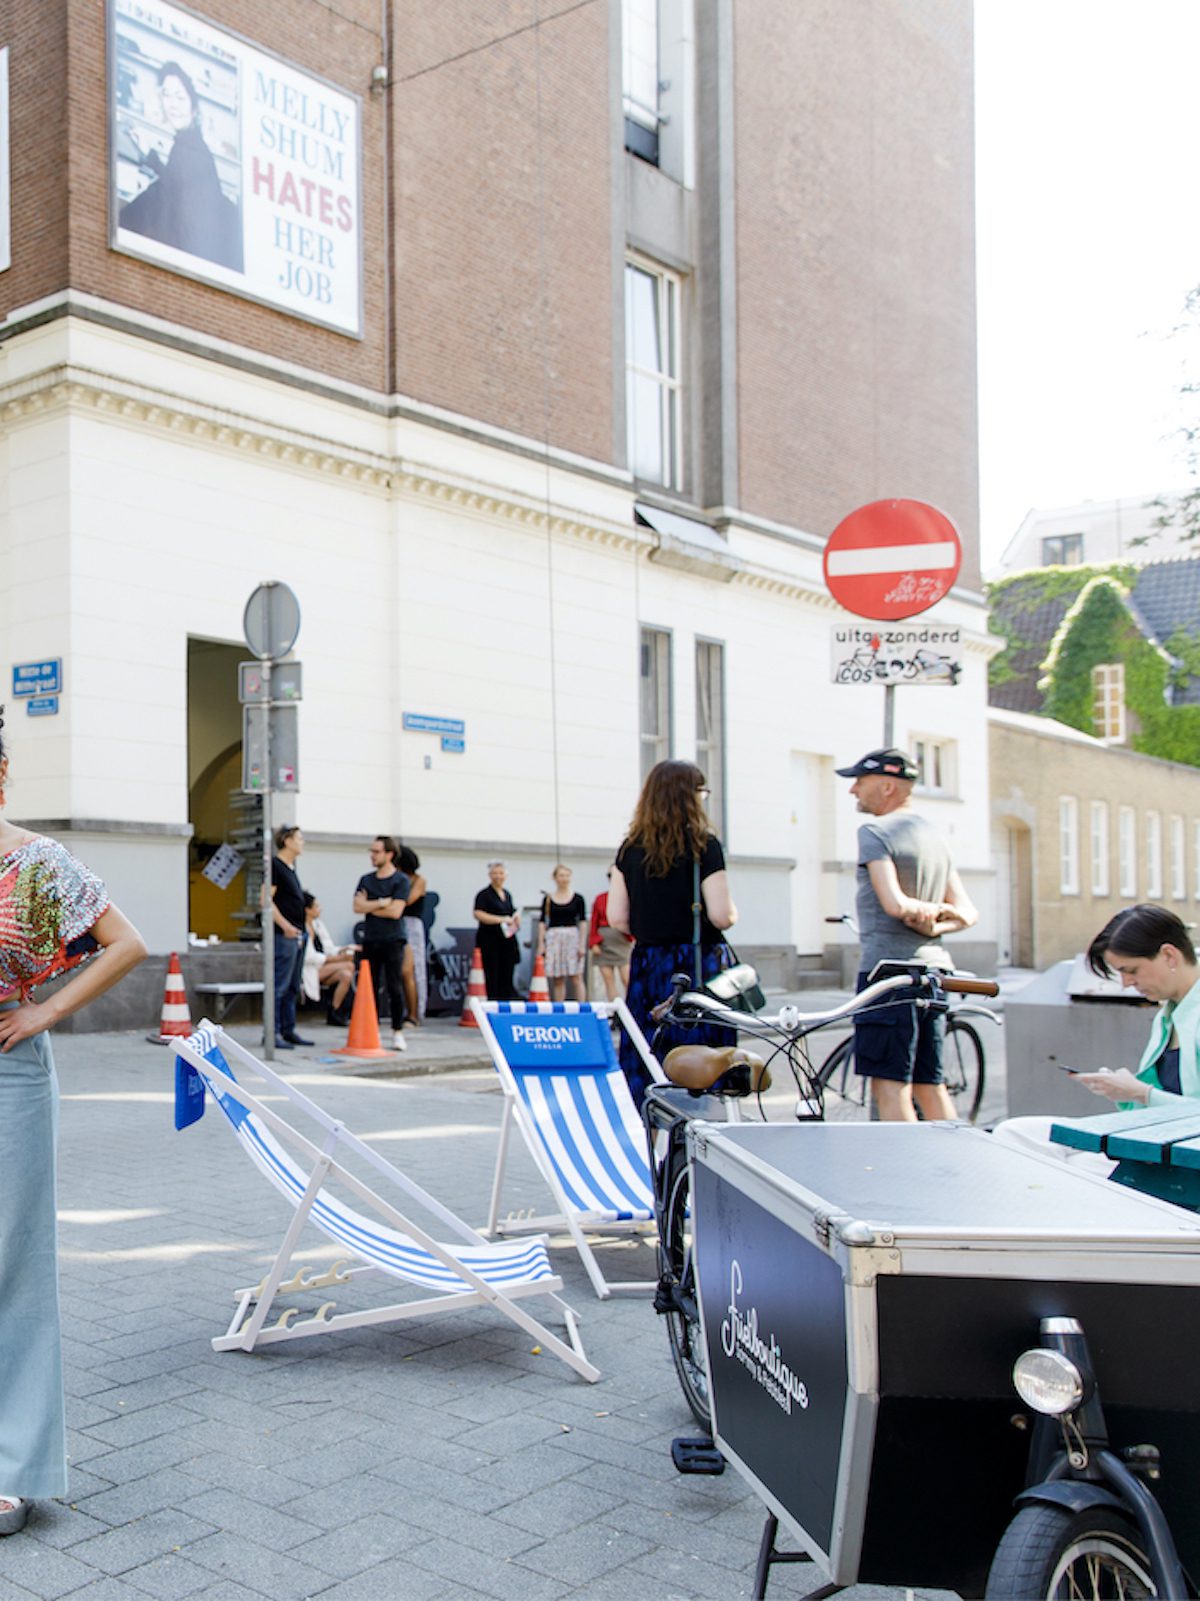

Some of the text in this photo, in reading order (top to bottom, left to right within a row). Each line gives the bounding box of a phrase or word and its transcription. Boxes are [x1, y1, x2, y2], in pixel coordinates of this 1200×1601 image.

[254, 68, 351, 145] MELLY
[259, 114, 345, 182] SHUM
[251, 155, 353, 233] HATES
[273, 215, 336, 270] HER
[278, 259, 333, 306] JOB
